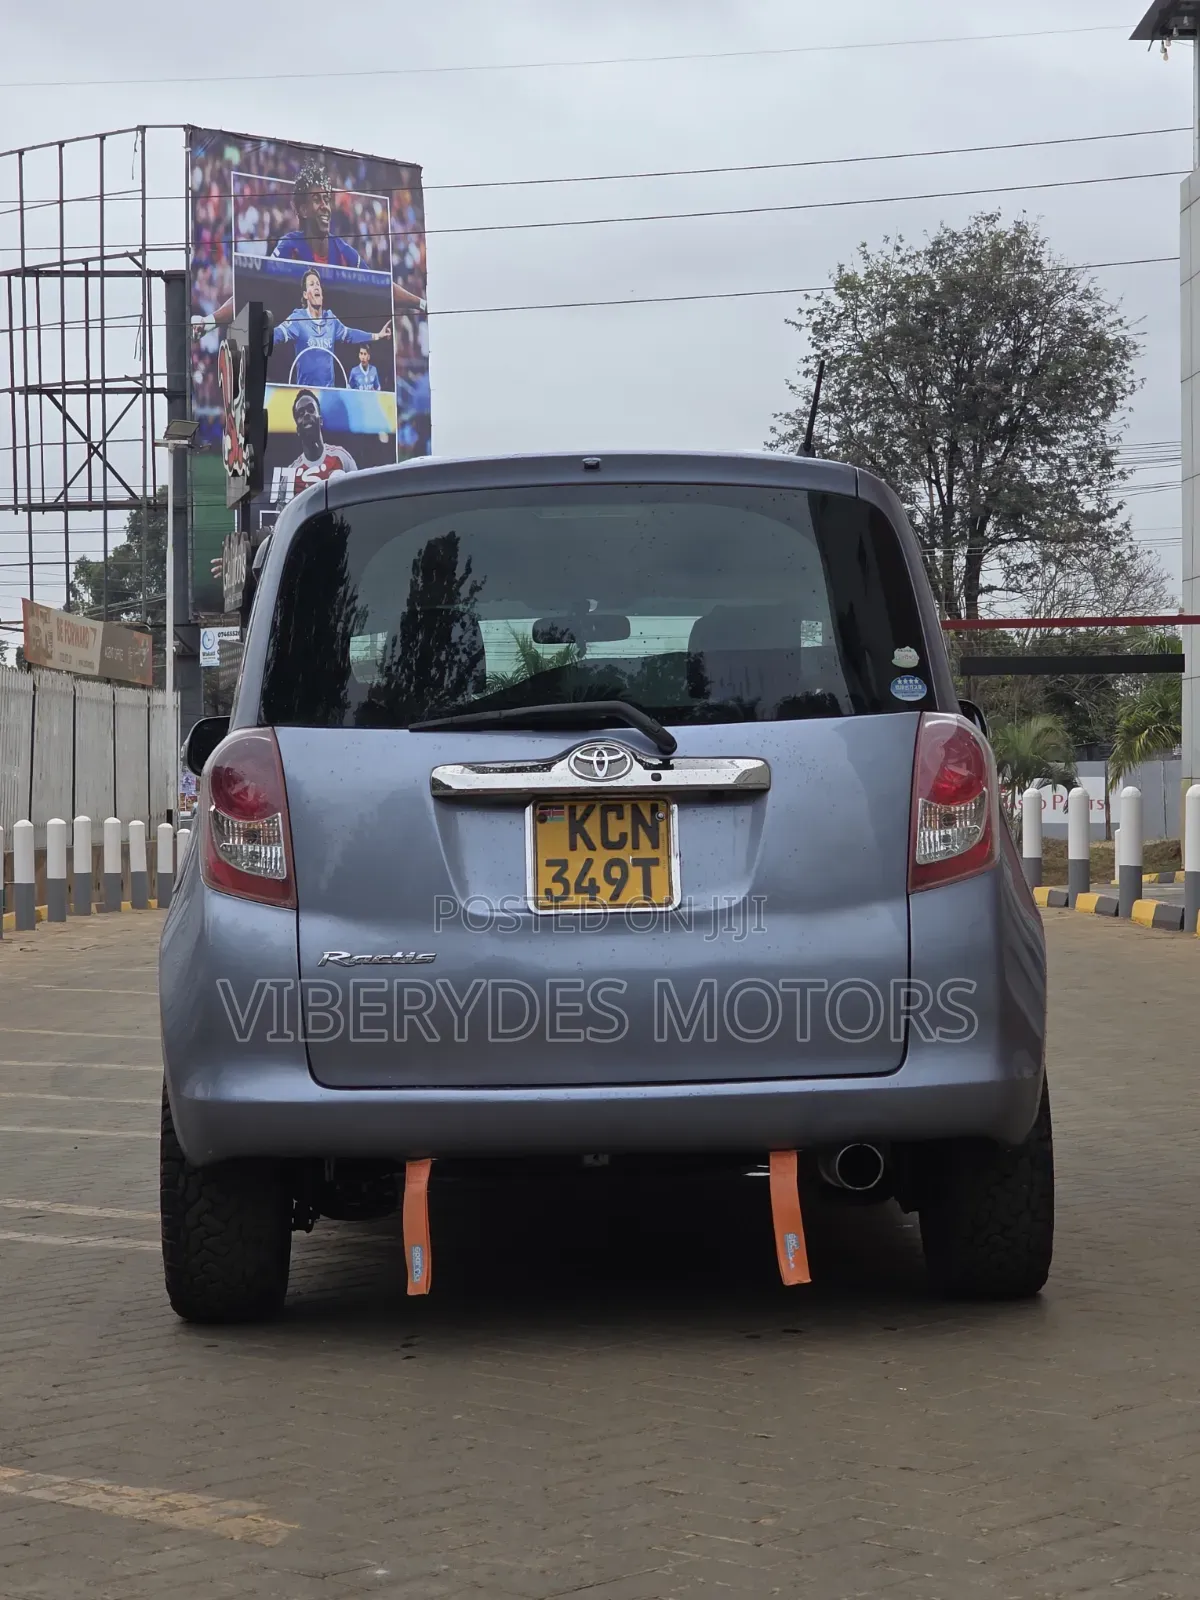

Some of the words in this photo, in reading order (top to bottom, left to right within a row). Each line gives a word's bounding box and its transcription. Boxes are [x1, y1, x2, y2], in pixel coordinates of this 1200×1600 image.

[568, 803, 660, 852] KCN
[544, 857, 660, 903] 349T
[317, 951, 437, 967] Ractis
